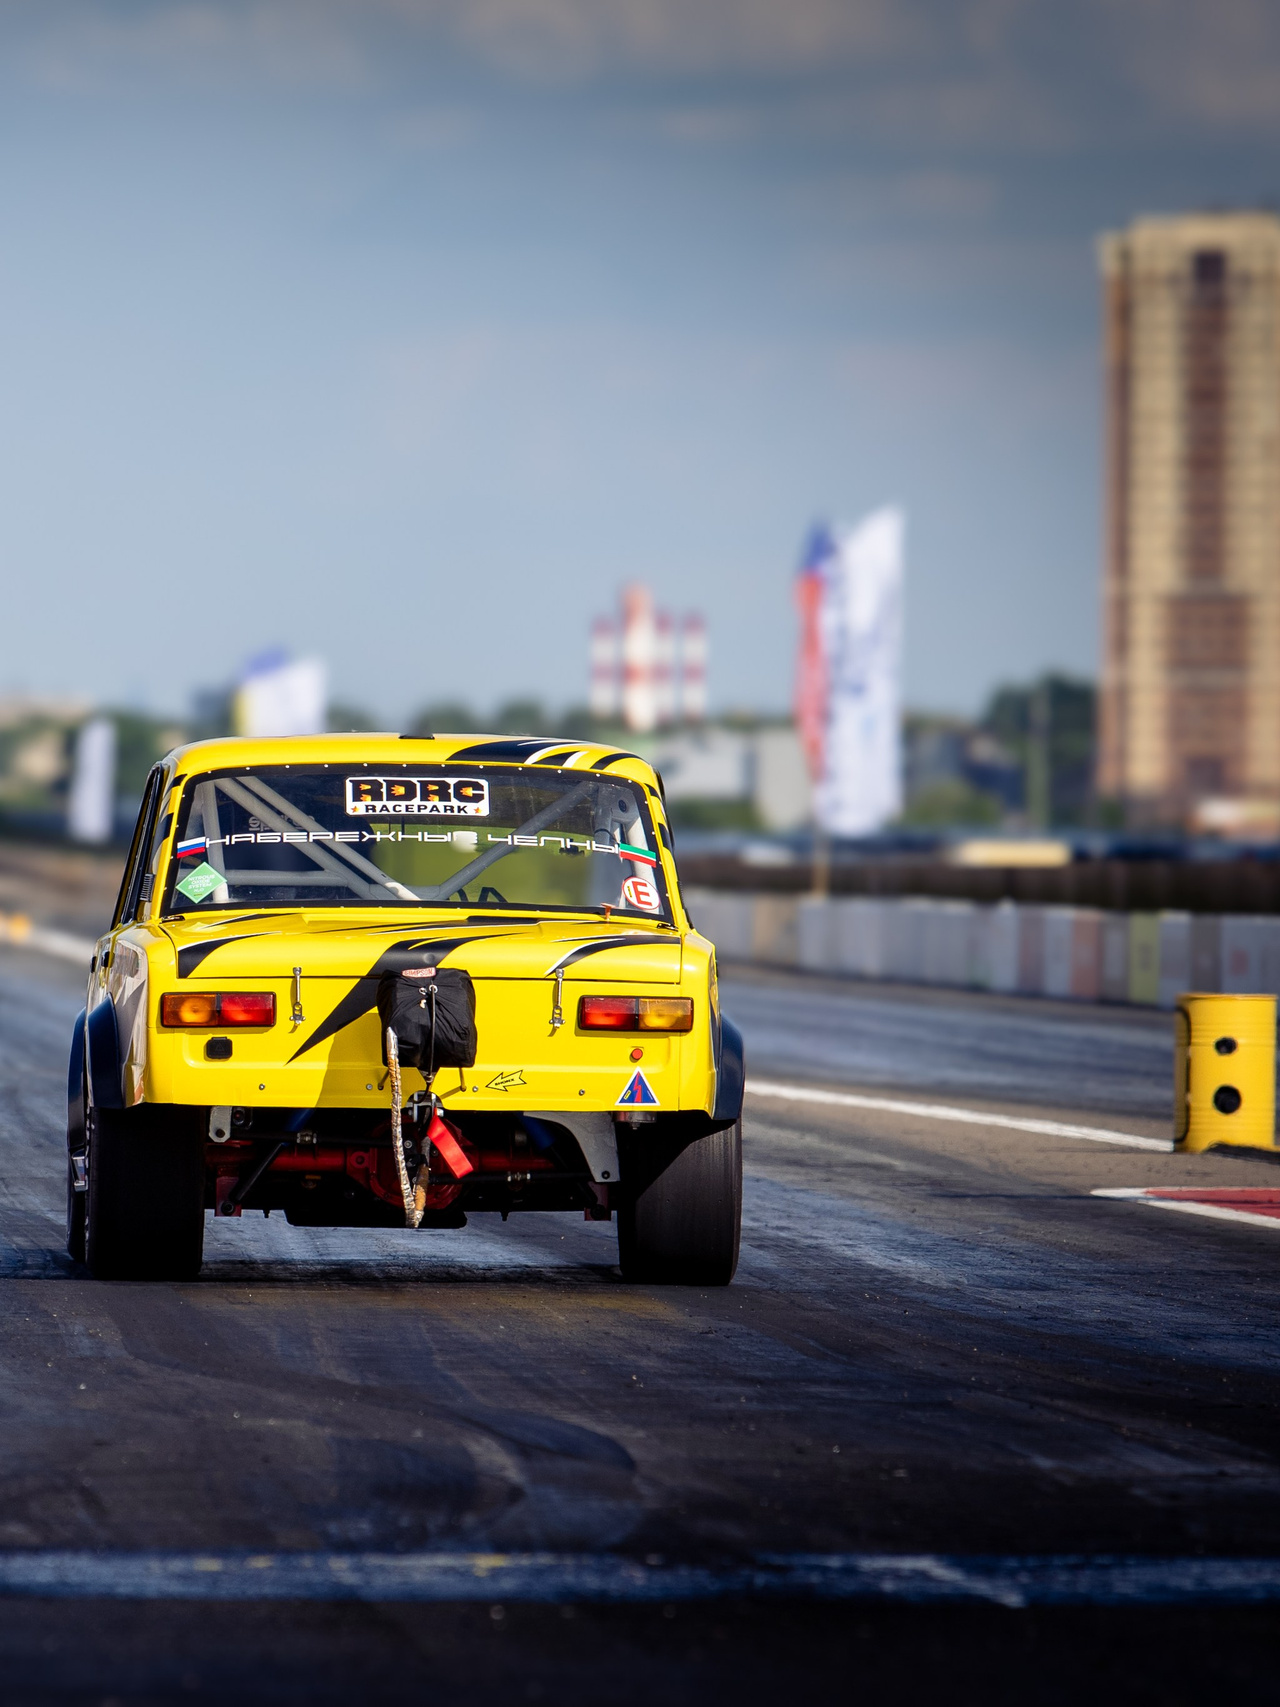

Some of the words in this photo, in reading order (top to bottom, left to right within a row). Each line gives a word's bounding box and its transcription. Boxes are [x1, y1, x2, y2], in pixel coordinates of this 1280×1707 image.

[349, 779, 485, 803] RDRC
[364, 804, 468, 814] RACEPARK
[487, 833, 619, 854] ЧЕЛНЫ
[631, 881, 653, 906] E
